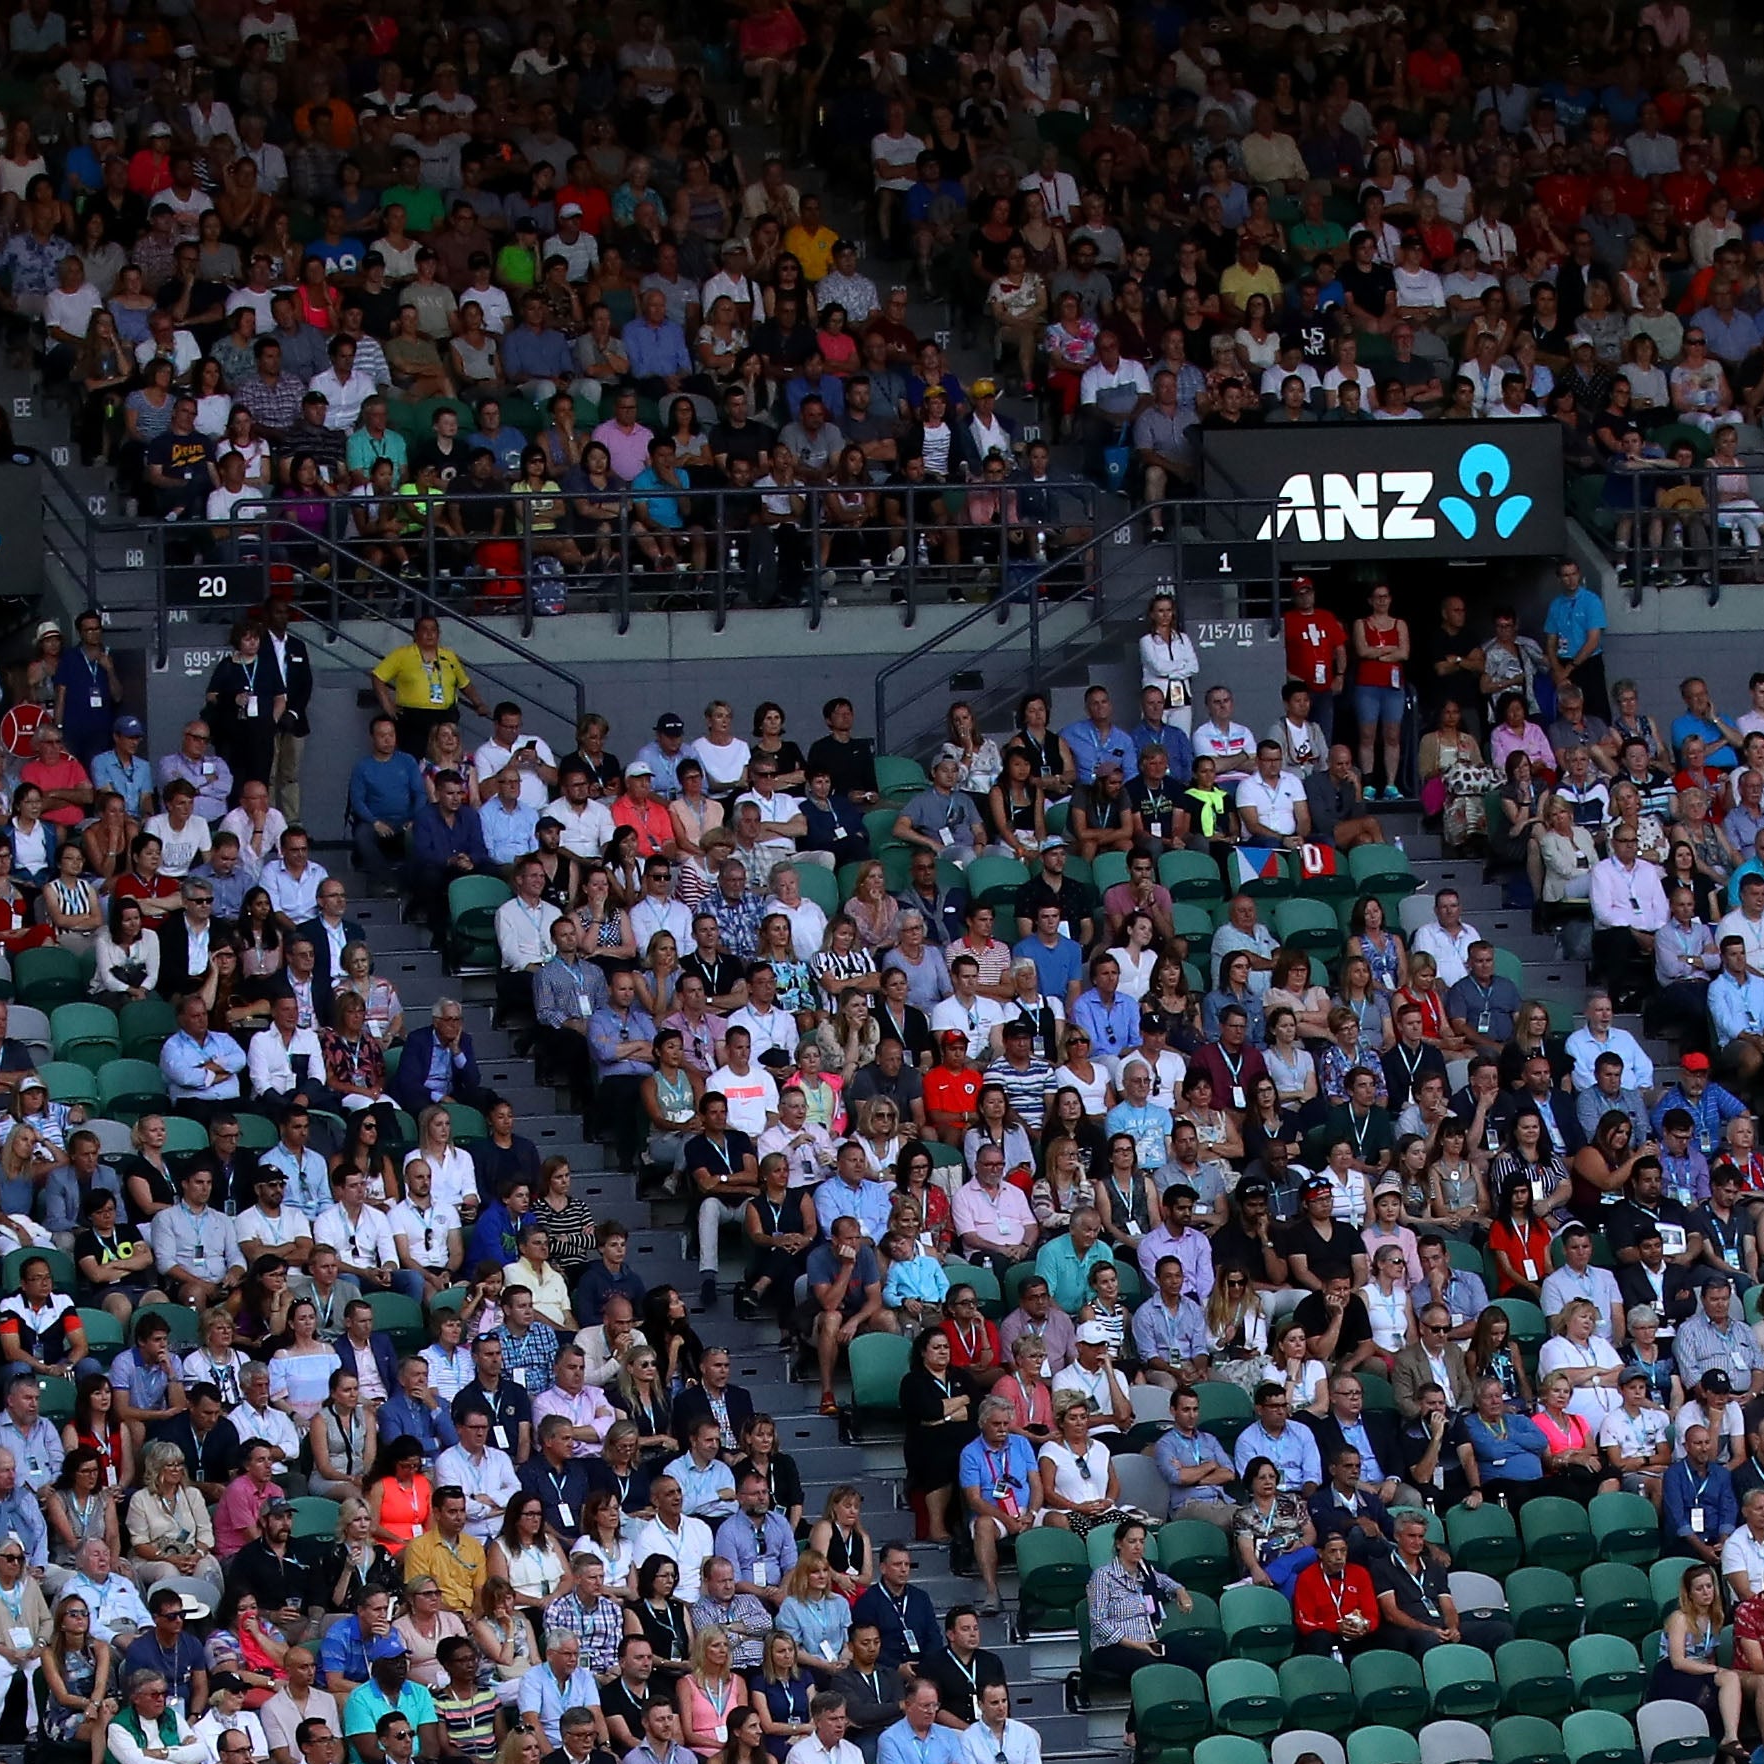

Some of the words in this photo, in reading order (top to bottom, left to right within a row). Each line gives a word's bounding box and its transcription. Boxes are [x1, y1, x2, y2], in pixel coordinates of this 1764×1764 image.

[13, 397, 32, 417] EE
[51, 447, 69, 466] DD
[88, 496, 106, 516] CC
[1256, 472, 1435, 541] ANZ
[1114, 526, 1131, 544] BB
[126, 549, 144, 568] BB
[1218, 552, 1232, 572] 1
[198, 576, 227, 597] 20
[1198, 623, 1253, 639] 715-716
